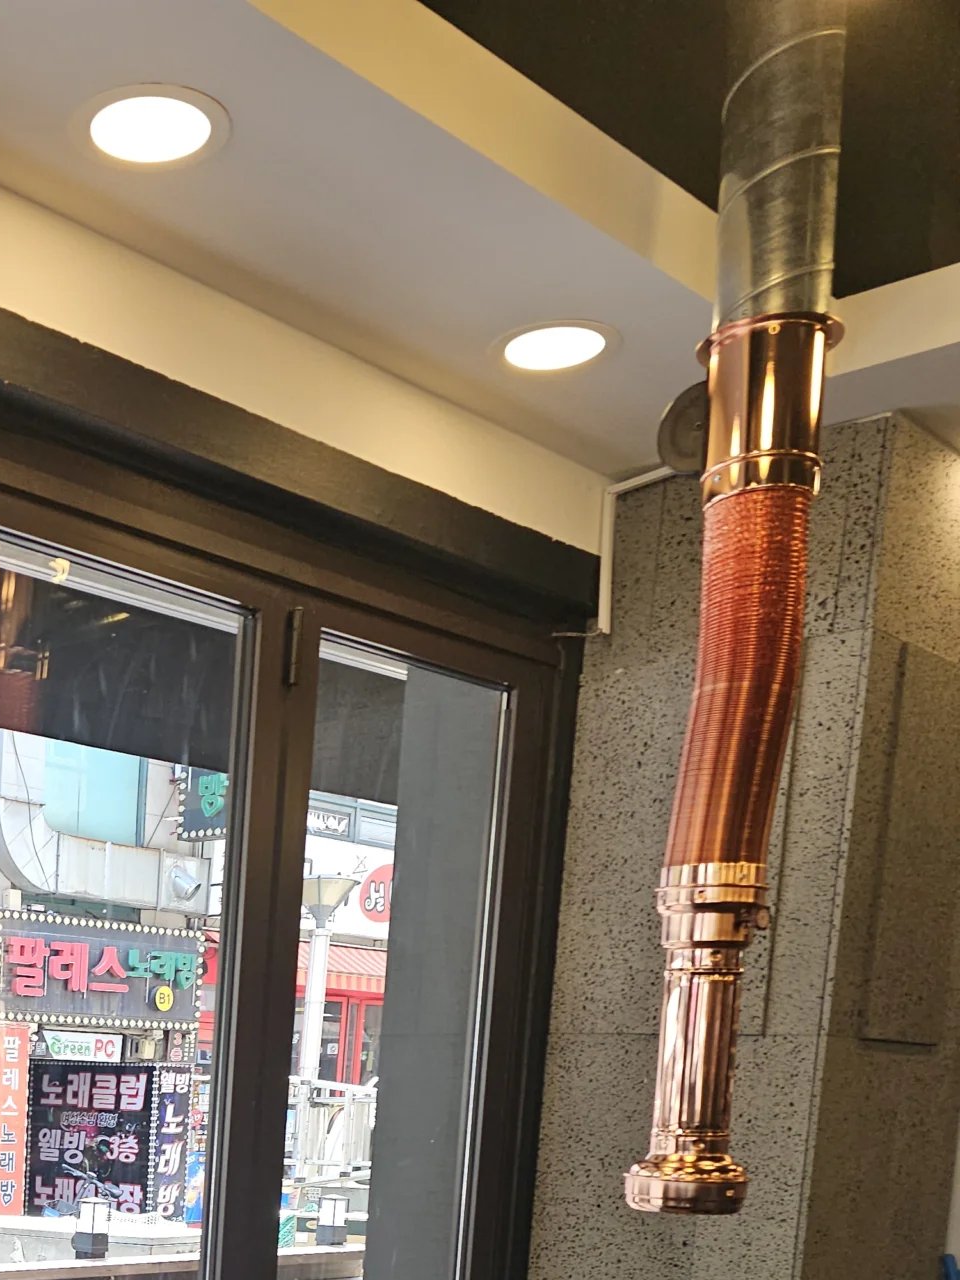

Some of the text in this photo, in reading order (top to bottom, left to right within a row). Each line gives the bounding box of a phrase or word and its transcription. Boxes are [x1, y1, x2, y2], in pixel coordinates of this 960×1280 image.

[7, 936, 196, 997] 팔레스 노래방
[50, 1037, 91, 1056] Green
[93, 1038, 115, 1058] PC
[40, 1072, 147, 1110] 노래클럽
[38, 1128, 139, 1164] 웰빙 3층
[156, 1103, 184, 1216] 노래방
[33, 1175, 144, 1214] 노래장
